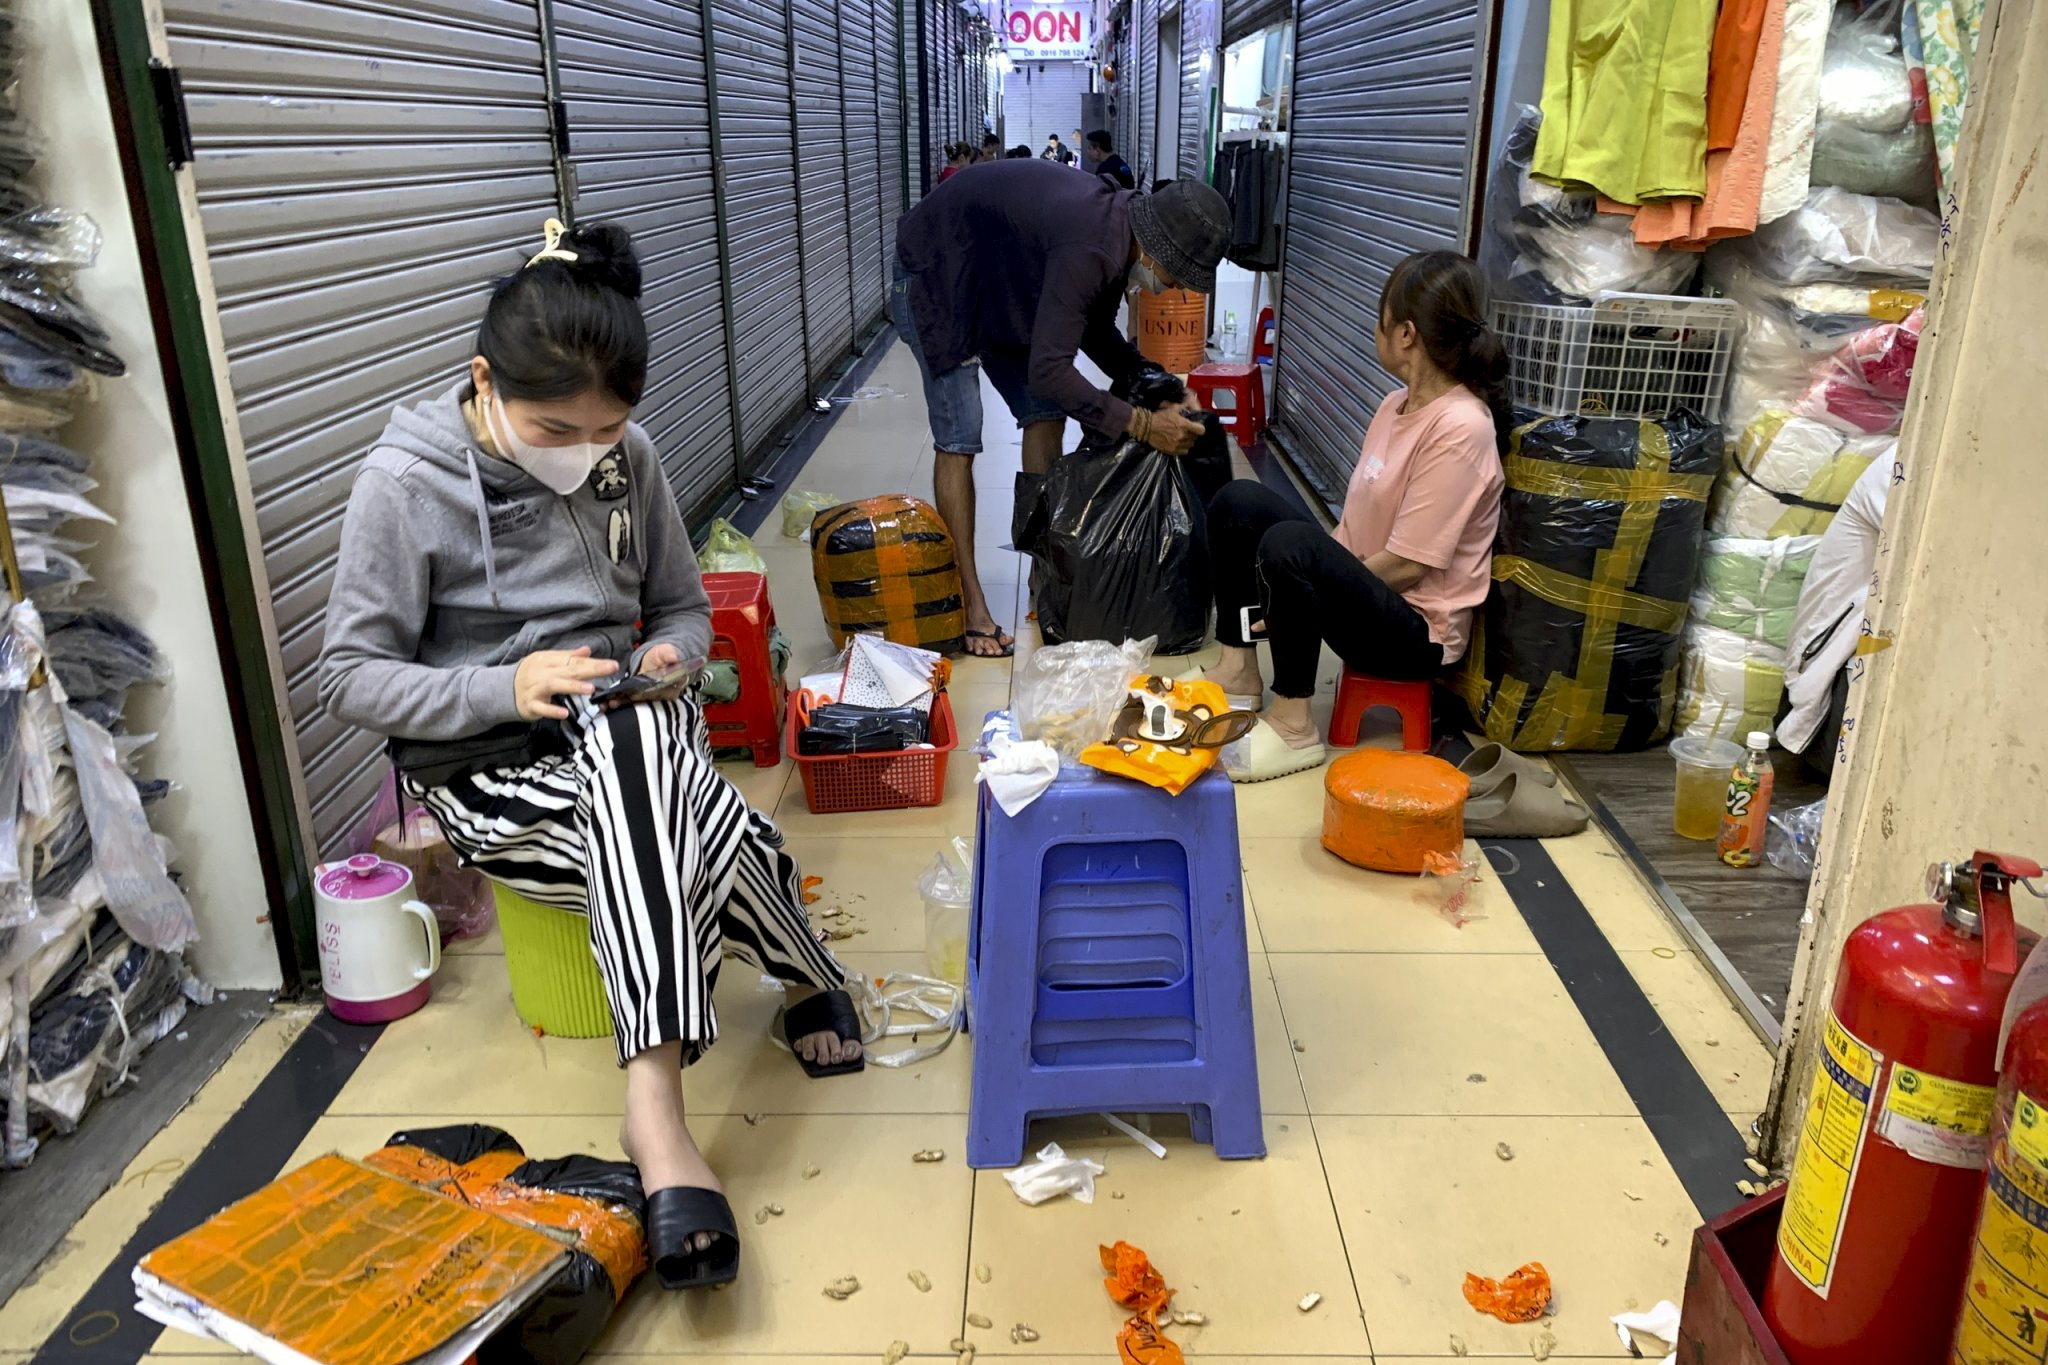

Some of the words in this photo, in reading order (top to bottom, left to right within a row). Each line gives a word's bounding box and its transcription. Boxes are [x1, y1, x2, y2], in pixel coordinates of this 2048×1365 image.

[1009, 11, 1080, 42] OON
[1145, 320, 1199, 336] USINE
[1726, 783, 1751, 816] C2
[1783, 1228, 1812, 1274] CHINA
